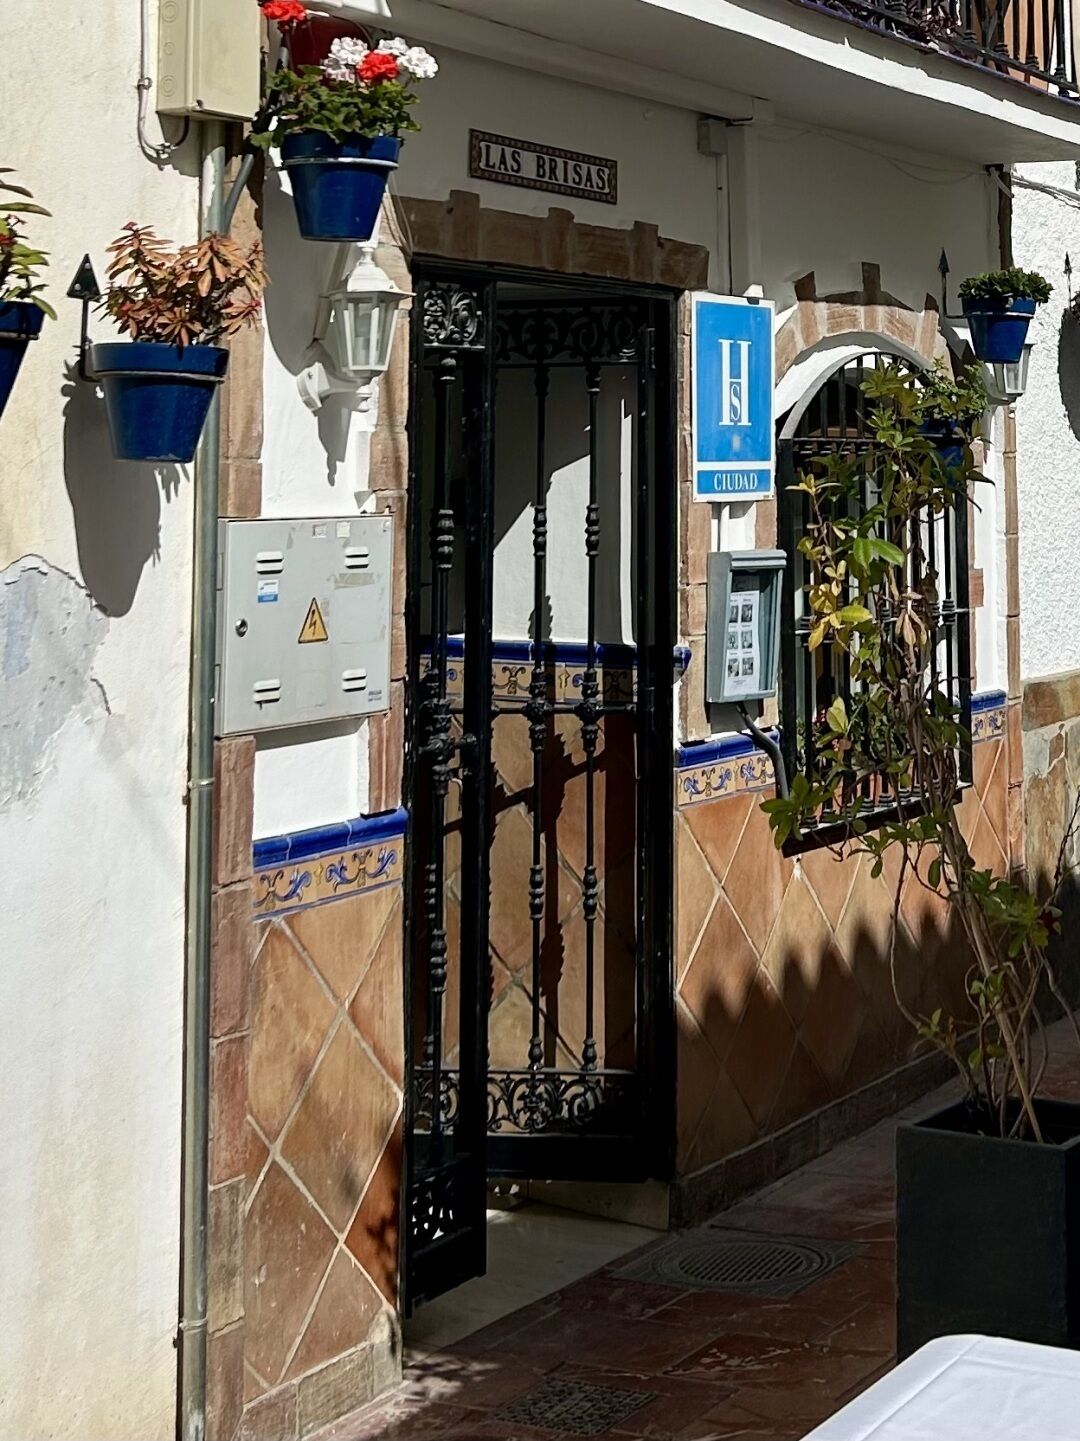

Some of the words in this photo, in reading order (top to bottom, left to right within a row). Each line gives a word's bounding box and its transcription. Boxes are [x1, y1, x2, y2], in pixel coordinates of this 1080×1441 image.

[484, 143, 522, 174] LAS
[536, 154, 608, 191] BRISAS
[713, 472, 758, 491] CIUDAD
